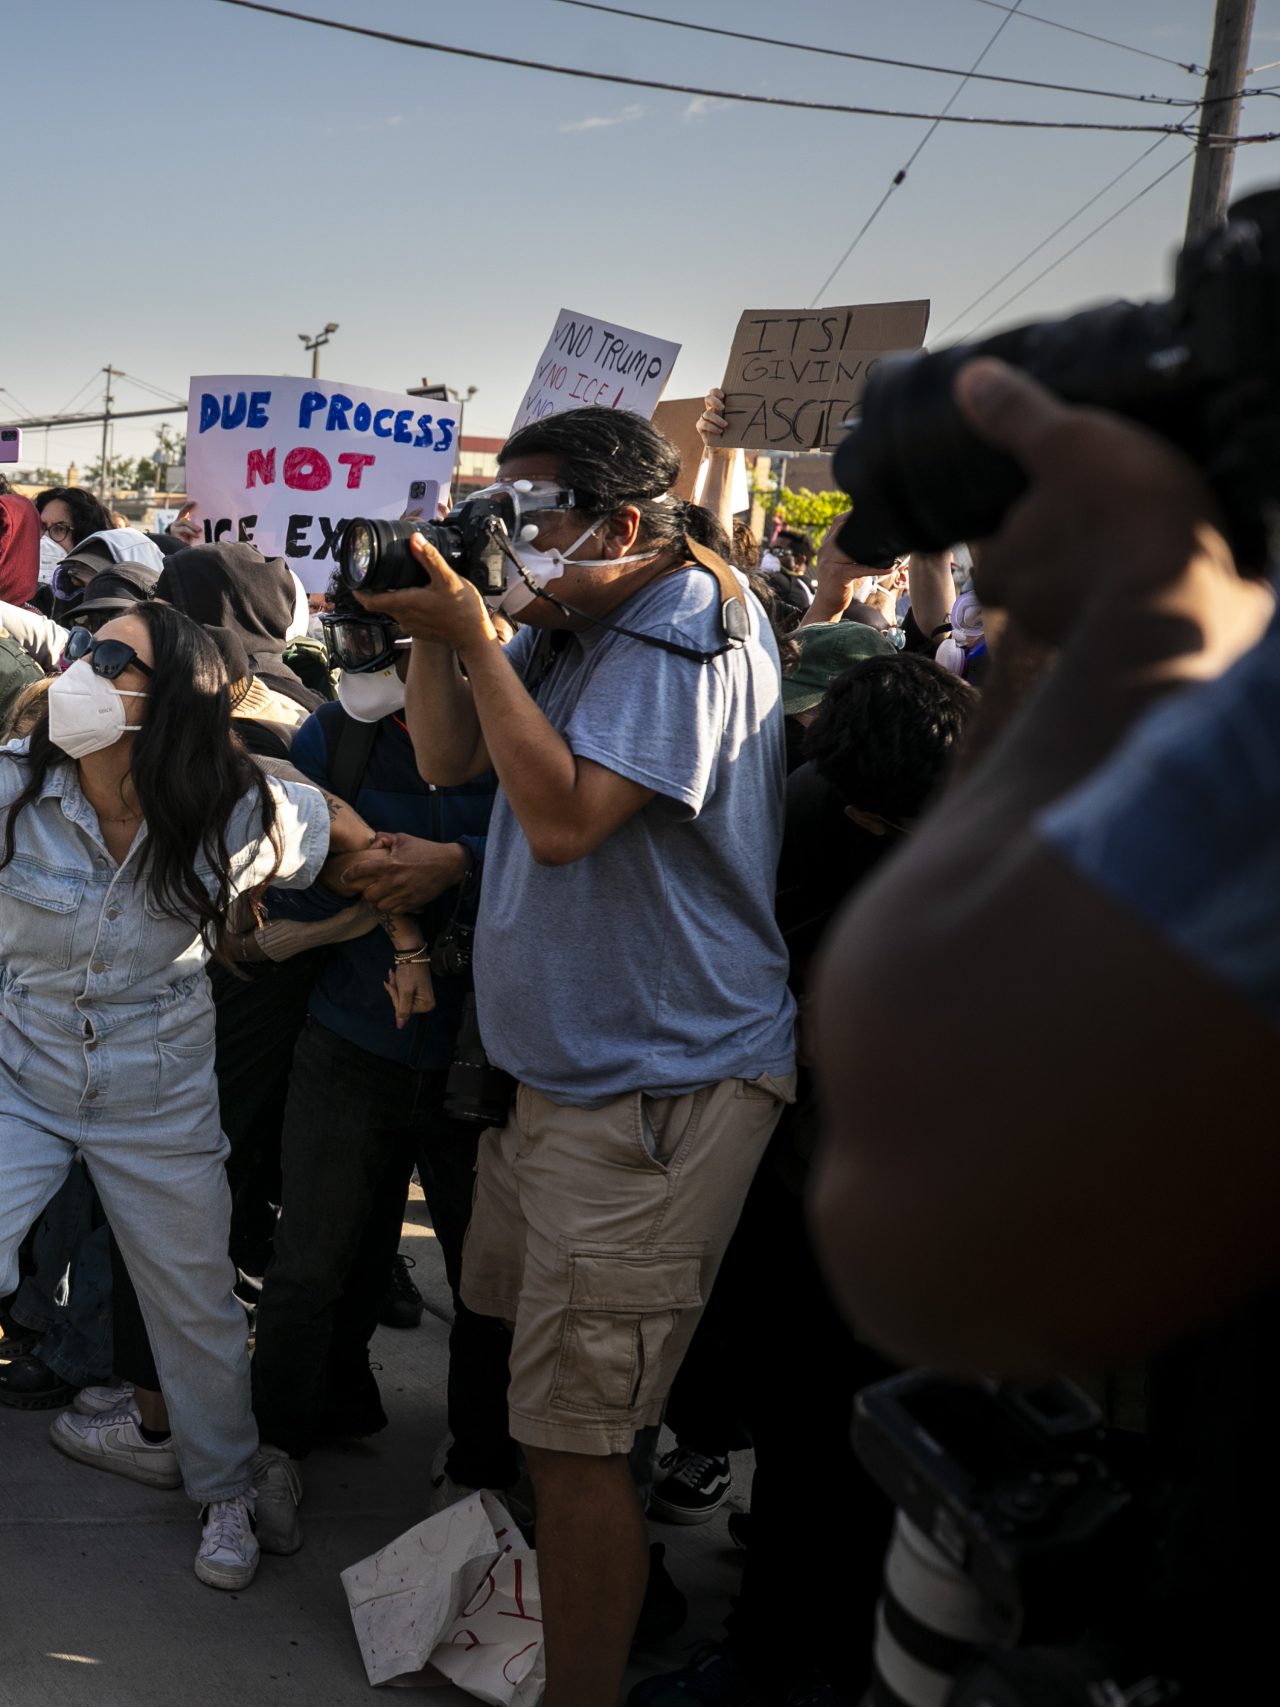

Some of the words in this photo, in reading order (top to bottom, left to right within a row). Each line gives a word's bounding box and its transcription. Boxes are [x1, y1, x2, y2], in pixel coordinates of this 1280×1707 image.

[544, 363, 567, 390] NO
[559, 321, 594, 358] NO
[594, 330, 662, 386] TRUMP
[199, 391, 271, 433] DUE
[298, 391, 455, 452] PROCESS
[246, 447, 375, 491] NOT
[285, 514, 346, 562] EX
